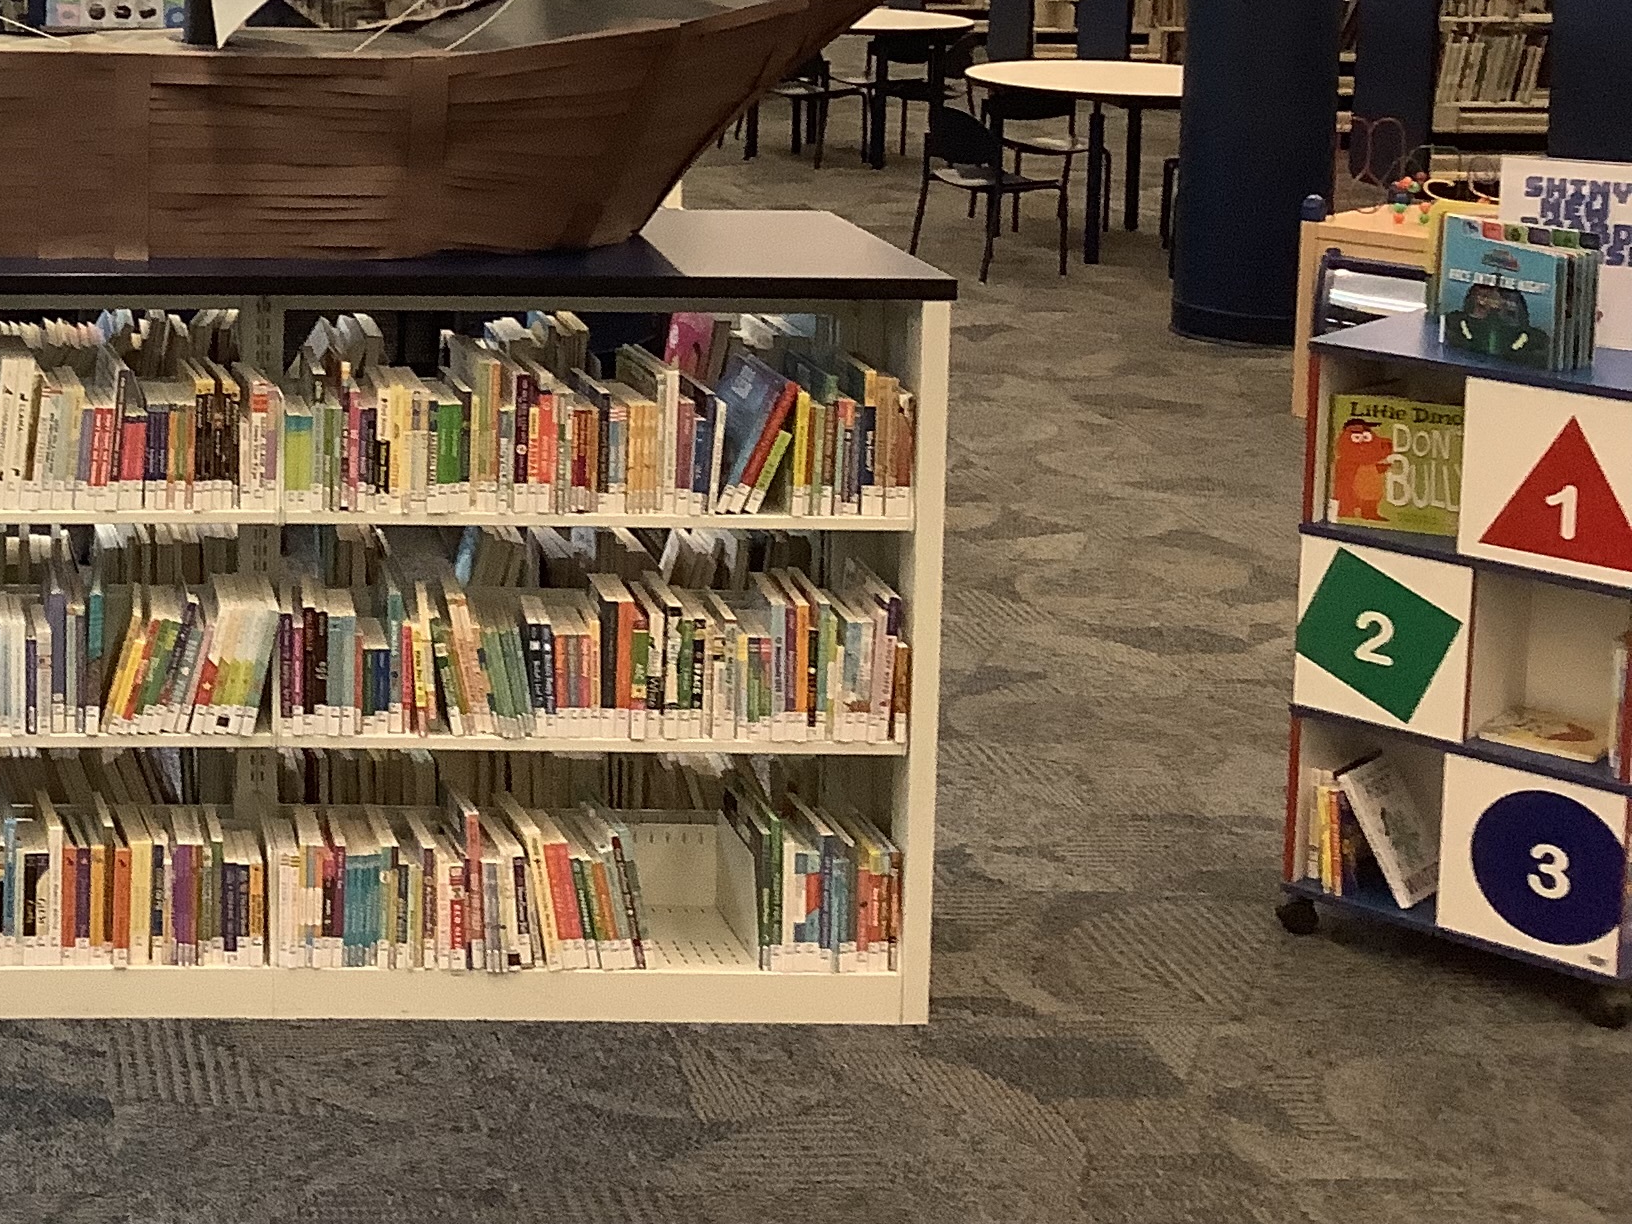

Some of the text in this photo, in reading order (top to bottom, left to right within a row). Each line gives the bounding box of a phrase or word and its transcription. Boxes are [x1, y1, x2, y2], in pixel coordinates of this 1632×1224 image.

[1349, 400, 1407, 421] Little
[1545, 484, 1578, 541] 1
[1354, 611, 1395, 667] 2
[1527, 843, 1572, 899] 3
